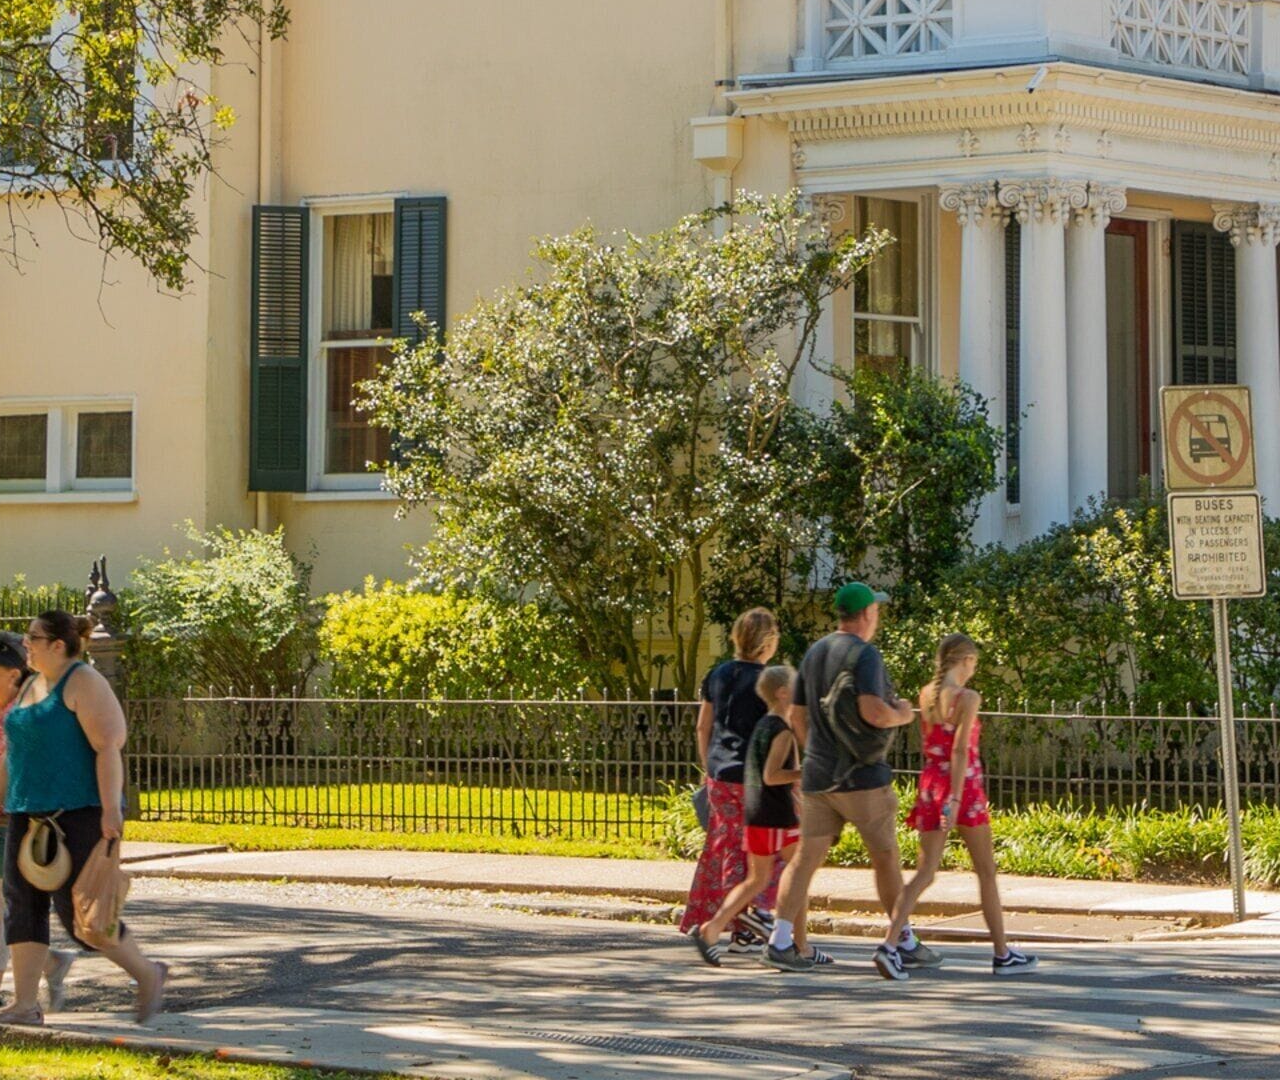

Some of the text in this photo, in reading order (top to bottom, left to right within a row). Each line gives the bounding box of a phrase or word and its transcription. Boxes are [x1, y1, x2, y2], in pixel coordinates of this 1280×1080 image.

[1195, 499, 1234, 511] BUSES
[1195, 514, 1221, 525] SEATING
[1224, 513, 1255, 524] CAPACITY
[1200, 526, 1230, 536] EXCESS
[1199, 537, 1249, 548] PASSENGERS
[1187, 551, 1248, 563] PROHIBITED
